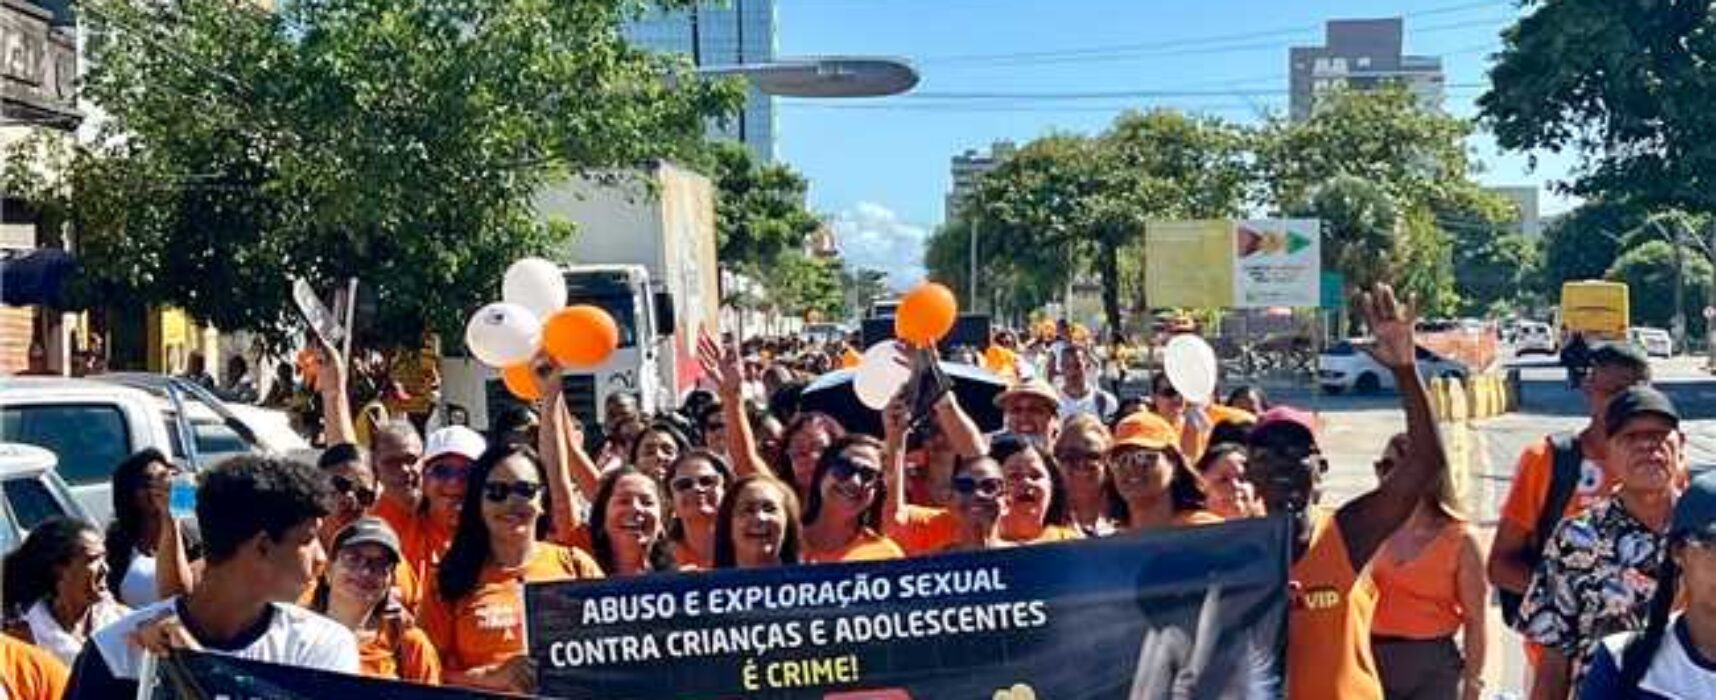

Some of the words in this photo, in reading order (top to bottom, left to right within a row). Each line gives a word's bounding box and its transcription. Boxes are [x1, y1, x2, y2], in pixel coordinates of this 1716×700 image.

[582, 593, 676, 625] ABUSO
[684, 591, 701, 617] E
[708, 573, 891, 611] EXPLORAÇÃO
[900, 567, 1007, 598] SEXUAL
[1305, 590, 1339, 609] VIP
[550, 634, 661, 668] CONTRA
[667, 622, 802, 656] CRIANÇAS
[809, 619, 827, 646] E
[835, 600, 1047, 643] ADOLESCENTES
[743, 659, 761, 690] É
[767, 656, 859, 688] CRIME!
